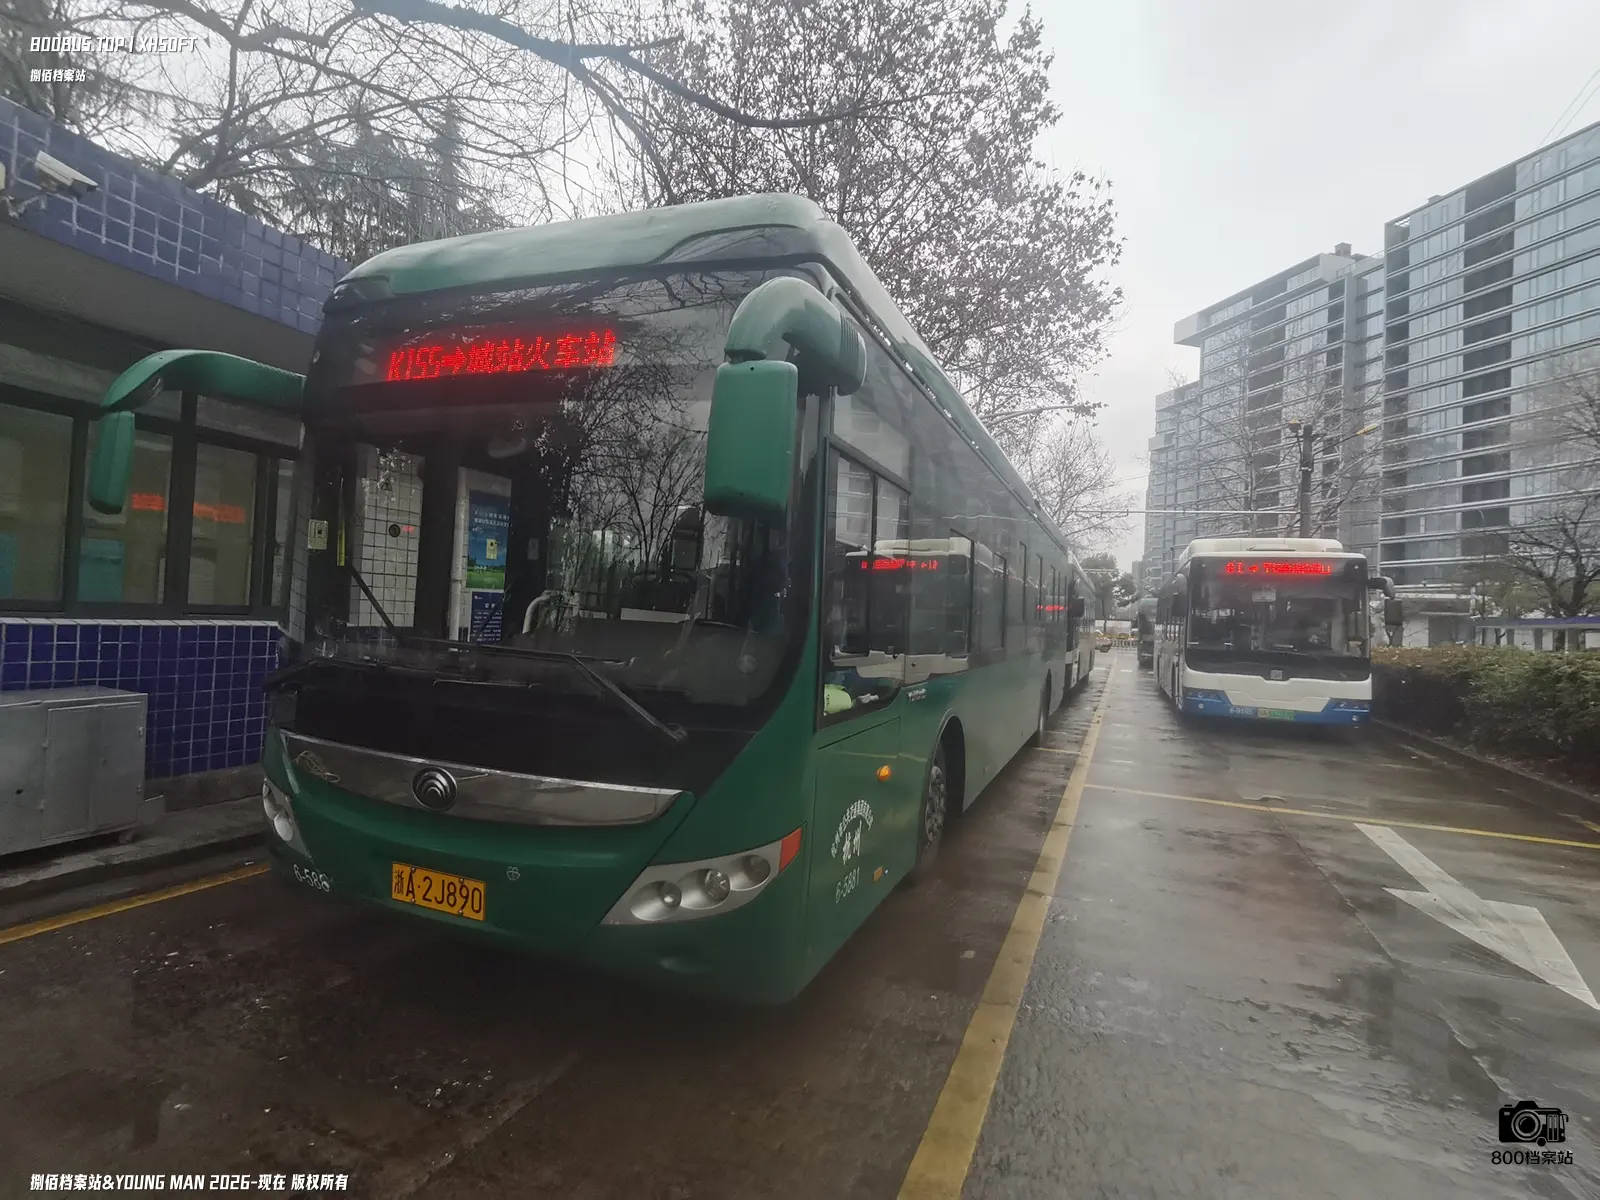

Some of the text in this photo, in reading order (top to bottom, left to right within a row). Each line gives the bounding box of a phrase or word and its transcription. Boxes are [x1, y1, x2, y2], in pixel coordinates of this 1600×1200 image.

[466, 329, 616, 374] 城站火车站
